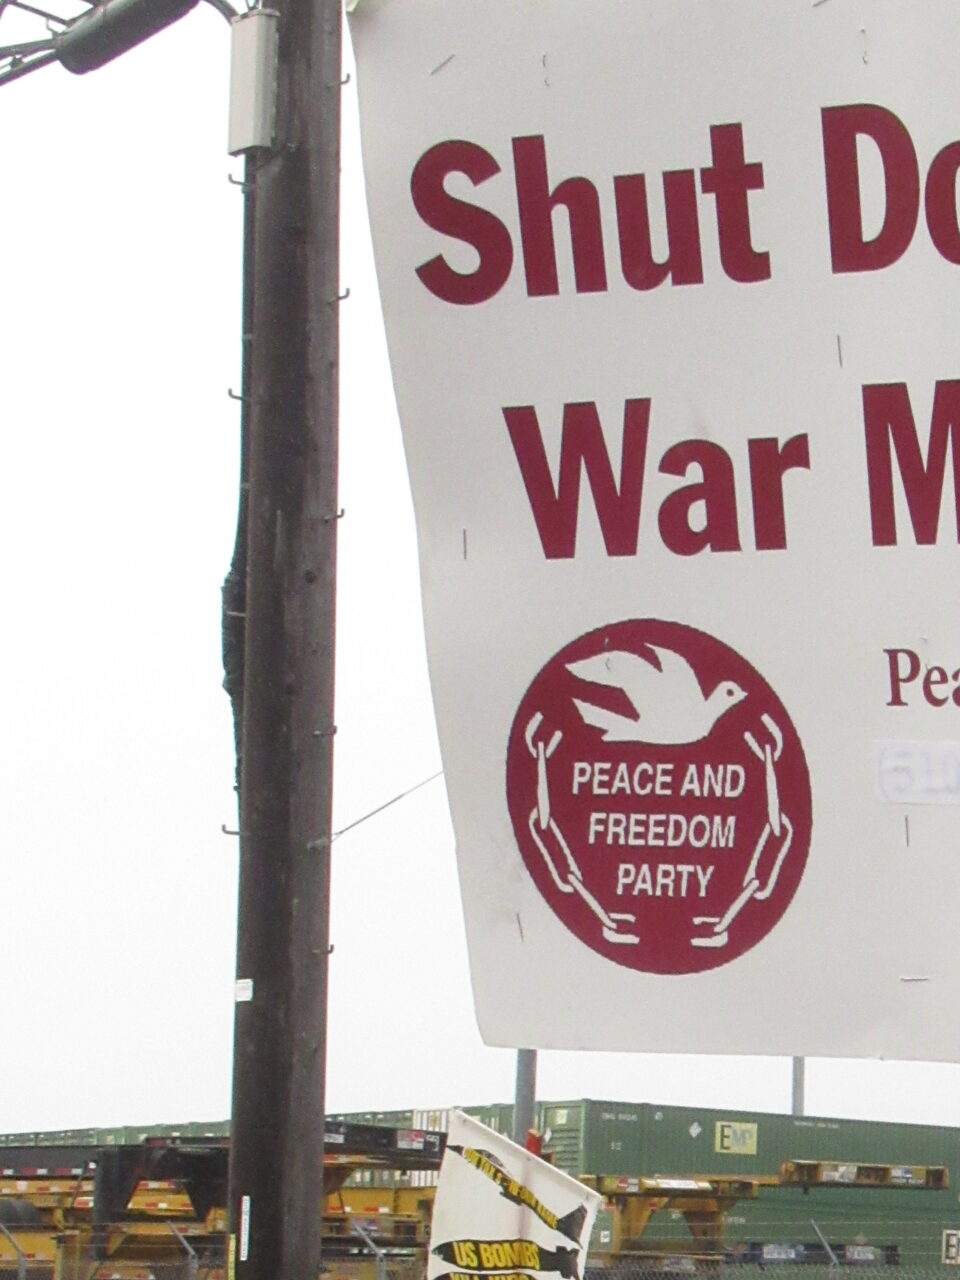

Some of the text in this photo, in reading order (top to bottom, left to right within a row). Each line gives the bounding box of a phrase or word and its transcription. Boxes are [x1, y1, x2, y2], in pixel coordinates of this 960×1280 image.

[410, 122, 772, 306] Shut
[501, 397, 811, 560] War
[572, 762, 746, 798] PEACE AND
[588, 812, 737, 848] FREEDOM
[616, 863, 715, 897] PARTY
[720, 1124, 753, 1150] EMP
[453, 1241, 541, 1271] US BOMBS
